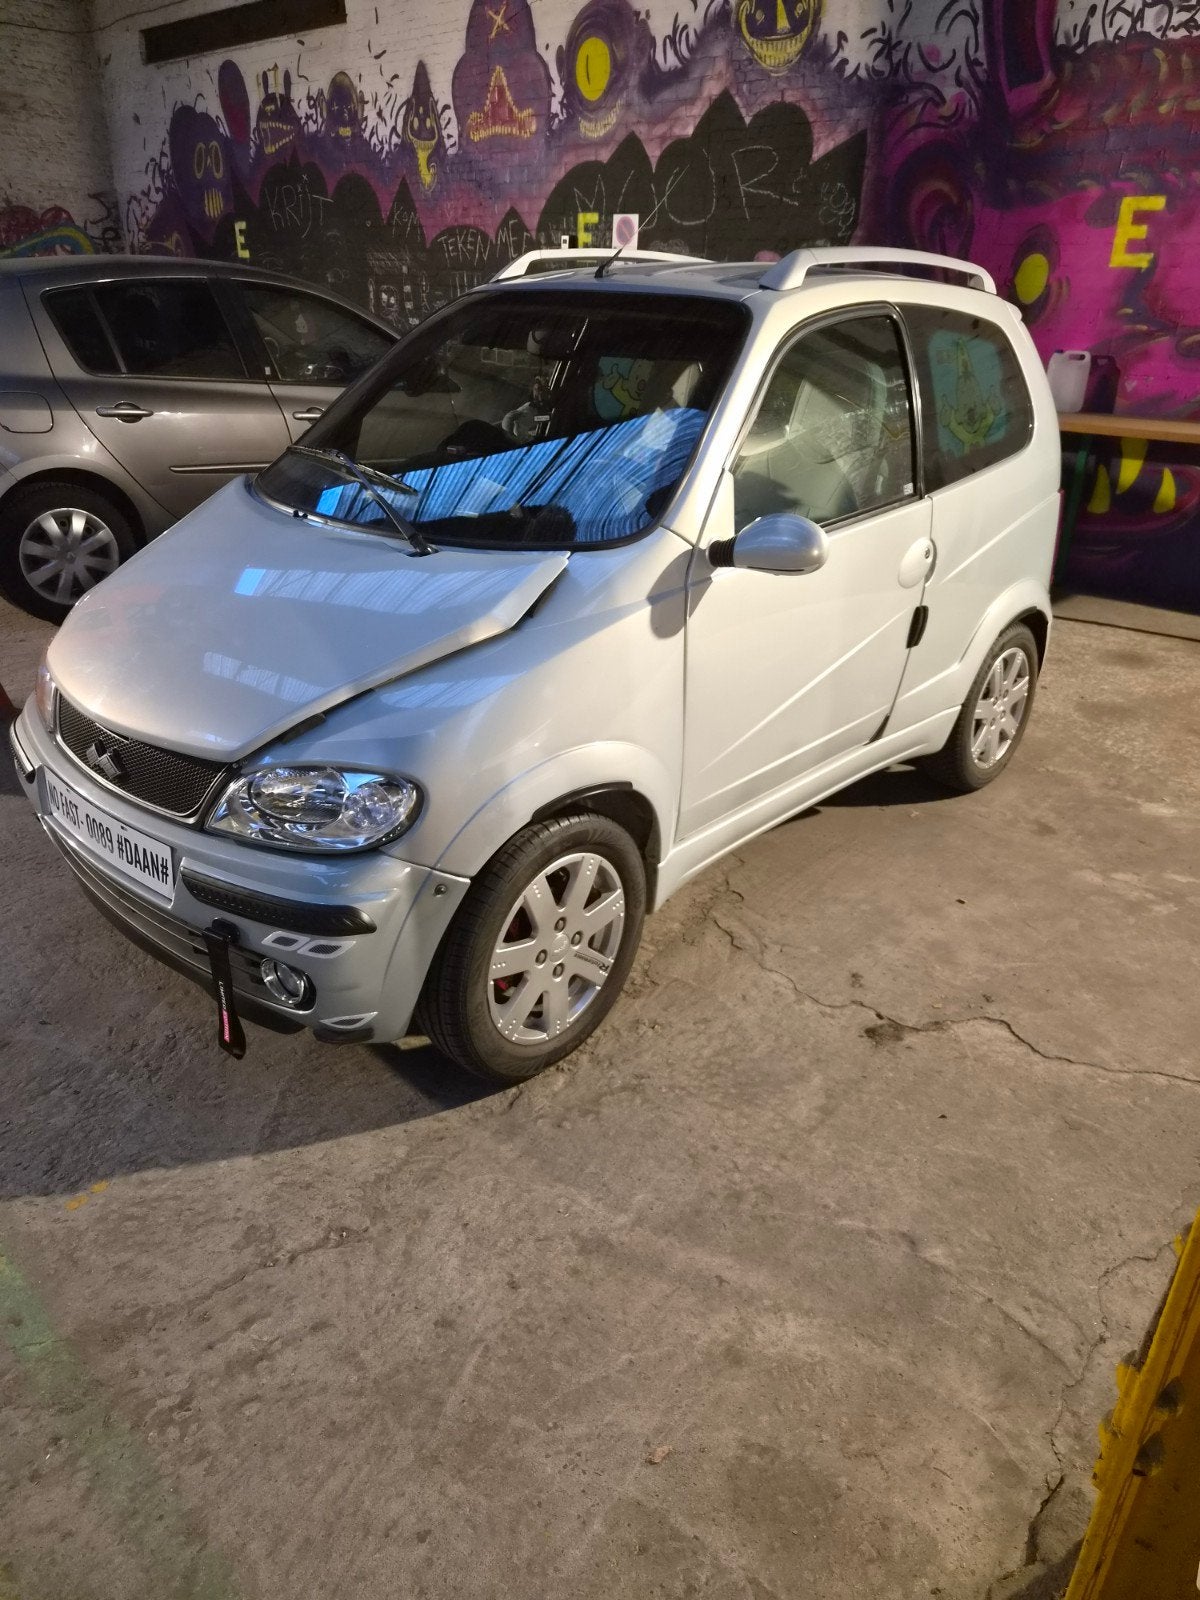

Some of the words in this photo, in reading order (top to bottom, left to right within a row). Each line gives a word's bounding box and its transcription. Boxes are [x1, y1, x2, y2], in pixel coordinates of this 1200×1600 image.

[48, 780, 60, 811] NO
[86, 813, 113, 854] 0089
[117, 834, 169, 884] #DAAN#
